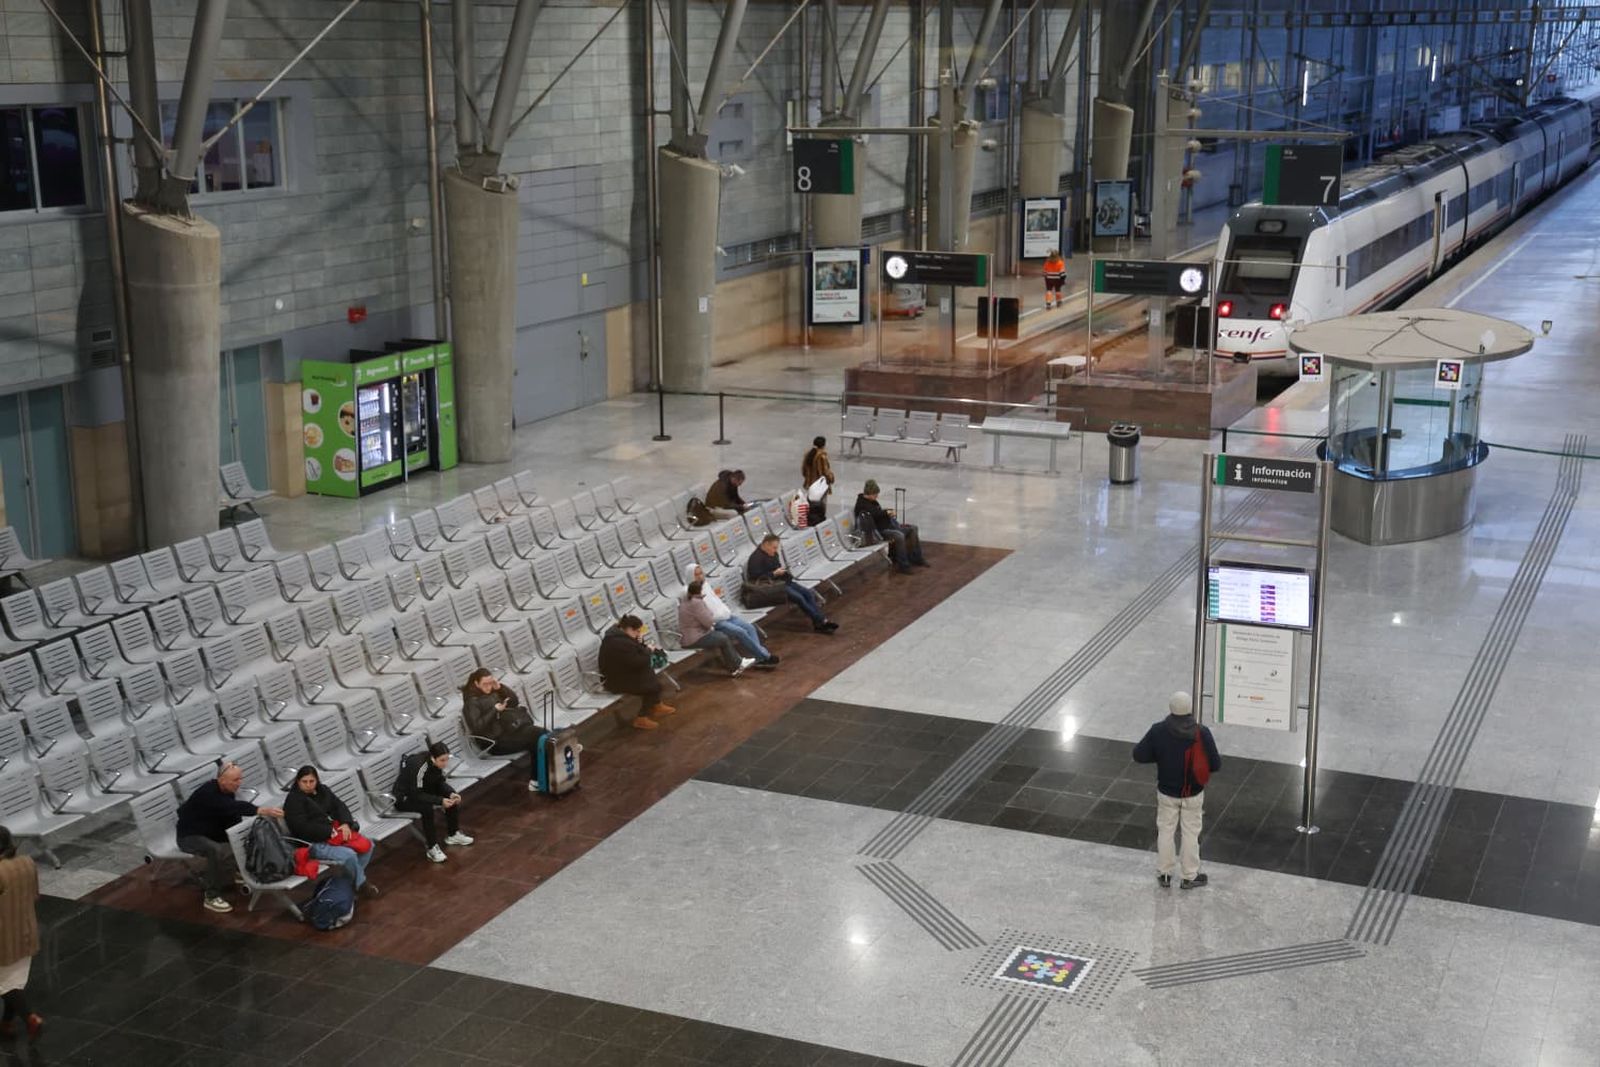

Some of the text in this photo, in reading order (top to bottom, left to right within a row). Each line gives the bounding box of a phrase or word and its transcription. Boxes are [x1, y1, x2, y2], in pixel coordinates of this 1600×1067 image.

[797, 166, 812, 191] 8
[1320, 175, 1337, 204] 7
[1251, 465, 1312, 479] Información
